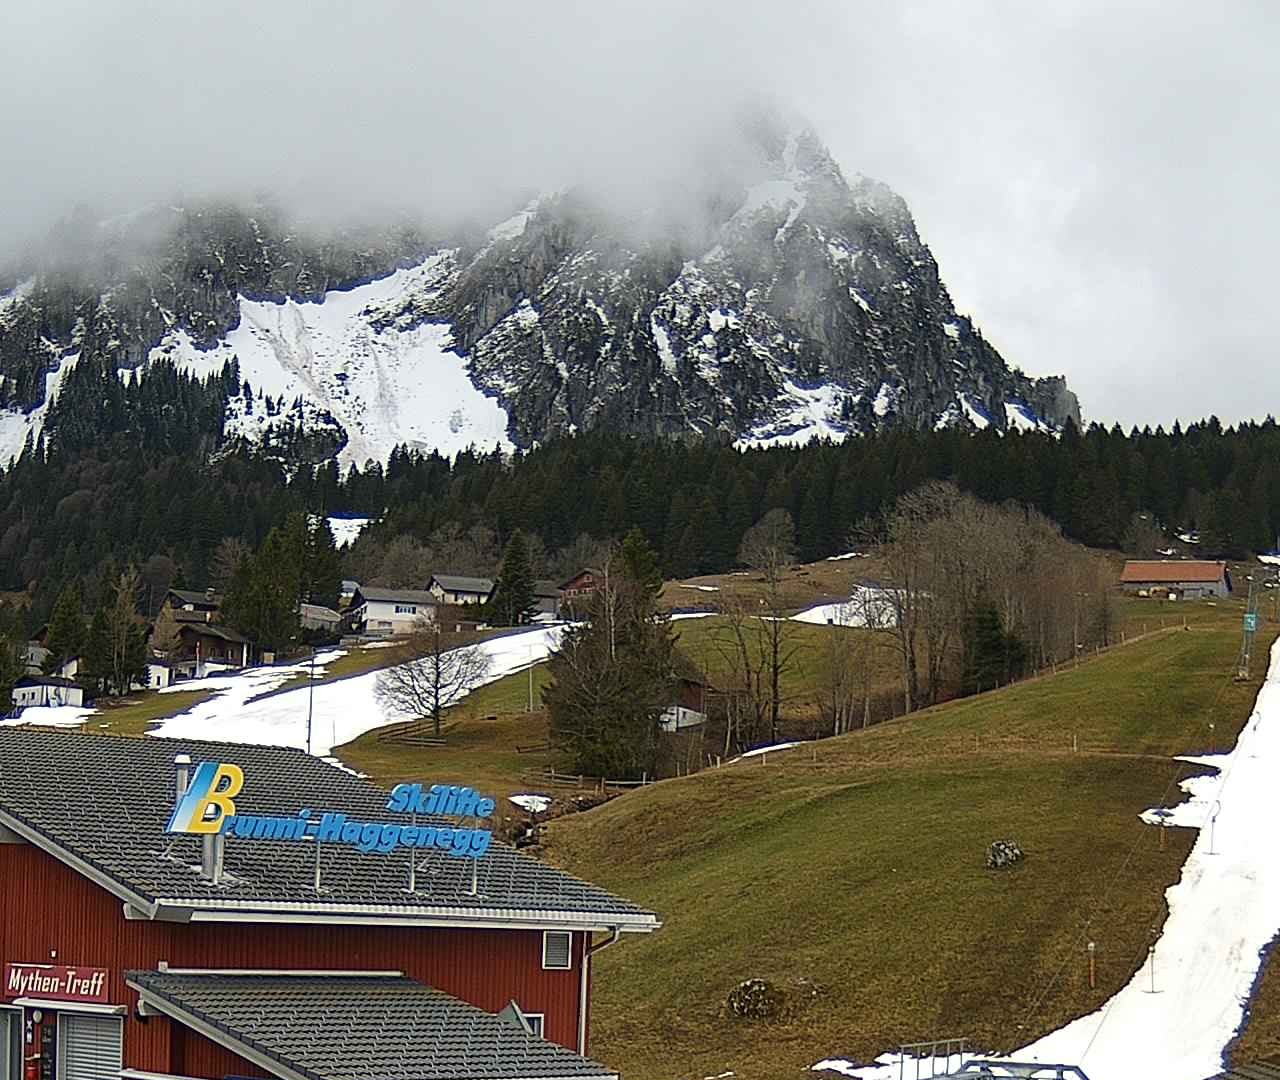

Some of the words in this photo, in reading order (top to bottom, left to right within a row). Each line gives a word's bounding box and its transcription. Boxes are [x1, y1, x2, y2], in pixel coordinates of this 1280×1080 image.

[166, 762, 493, 857] Brunni-Haggenegg
[386, 783, 497, 818] Skilifte
[8, 967, 105, 996] Mythen-Treff
